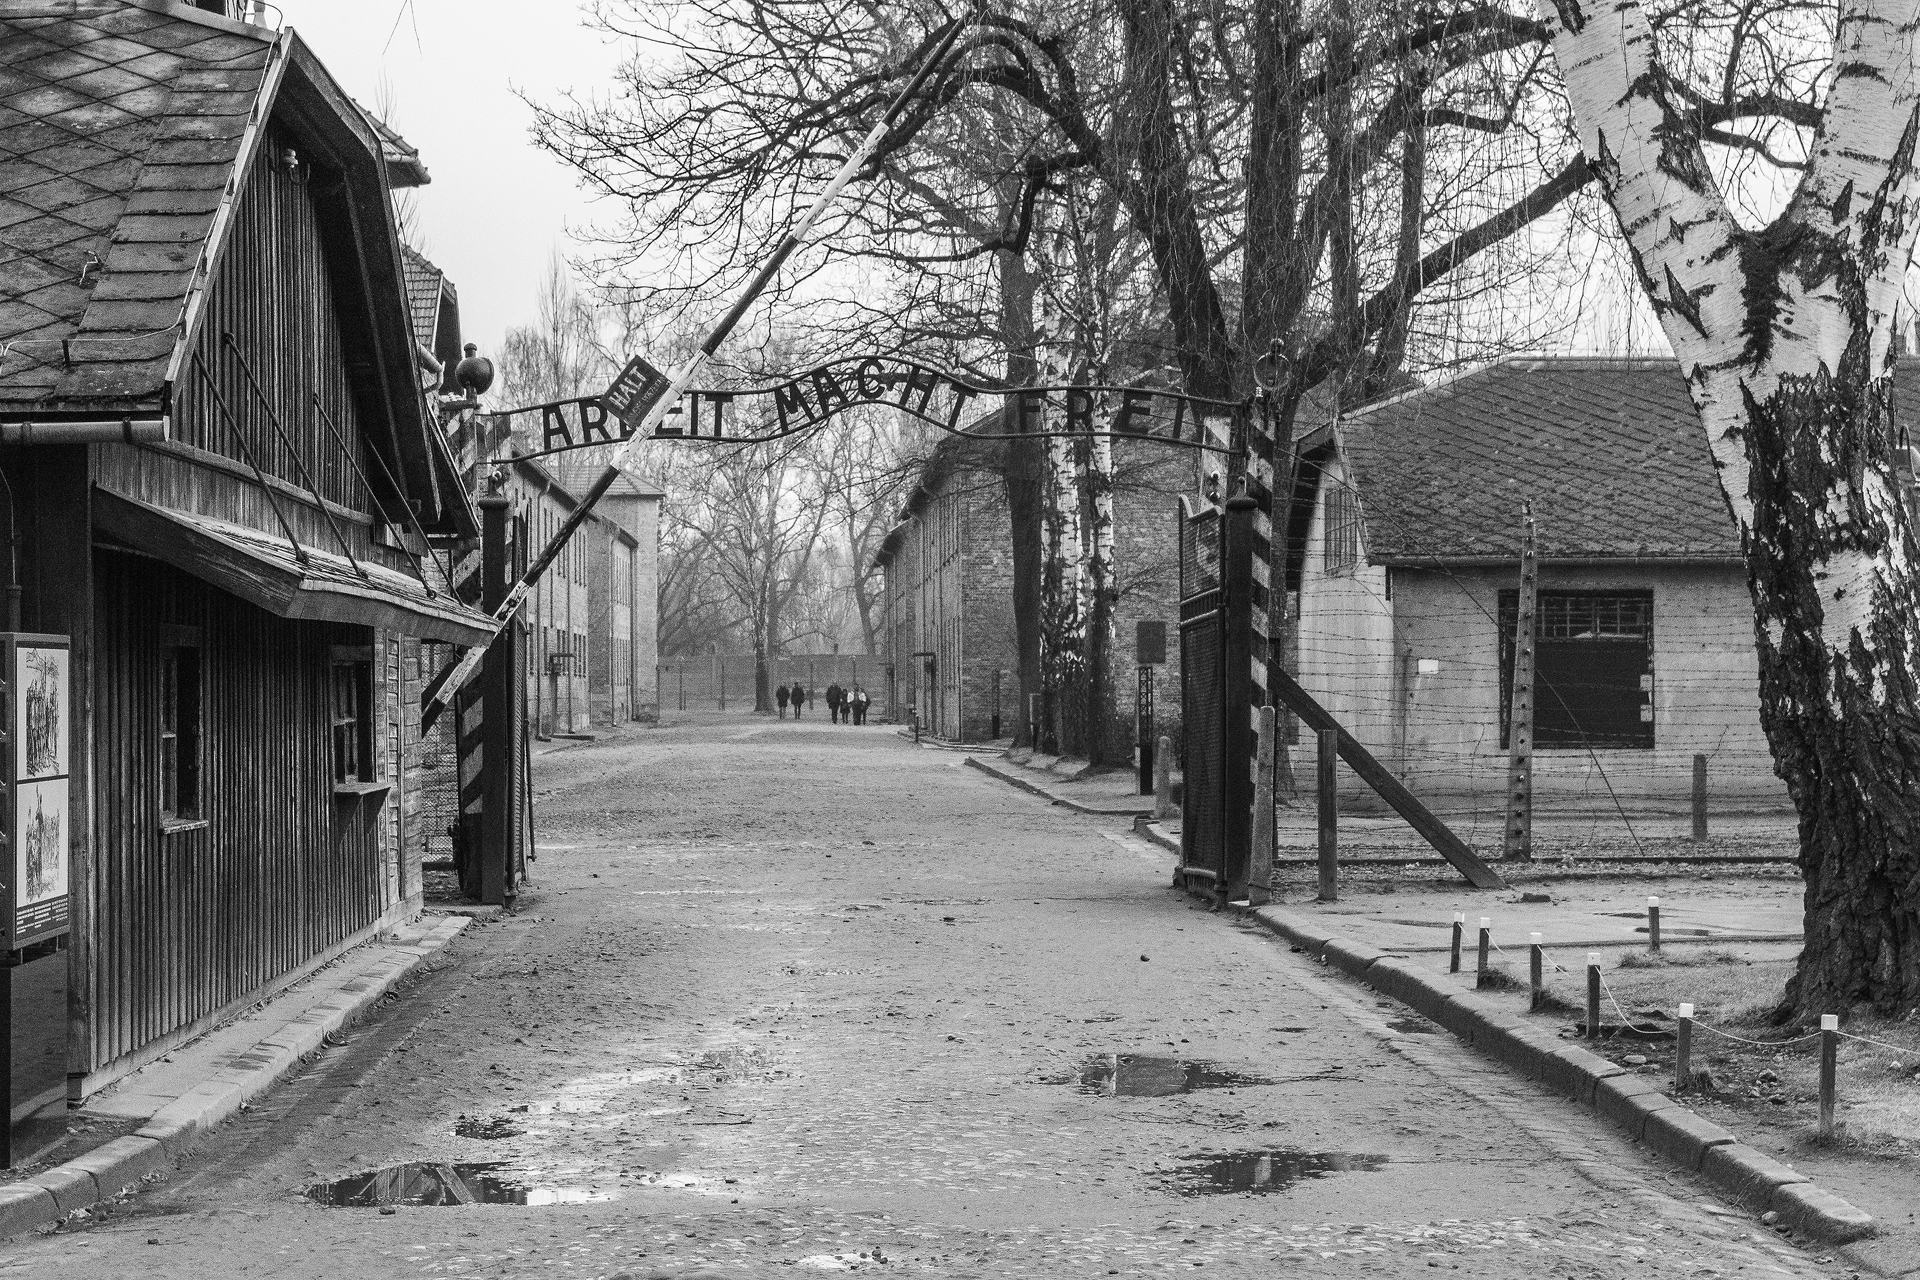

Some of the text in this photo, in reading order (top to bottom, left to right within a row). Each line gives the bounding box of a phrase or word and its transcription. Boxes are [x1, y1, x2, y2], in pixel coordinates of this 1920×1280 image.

[542, 392, 734, 450] AREIT
[774, 358, 977, 432] MACHT
[1019, 388, 1185, 438] FREI
[608, 366, 647, 409] HALT
